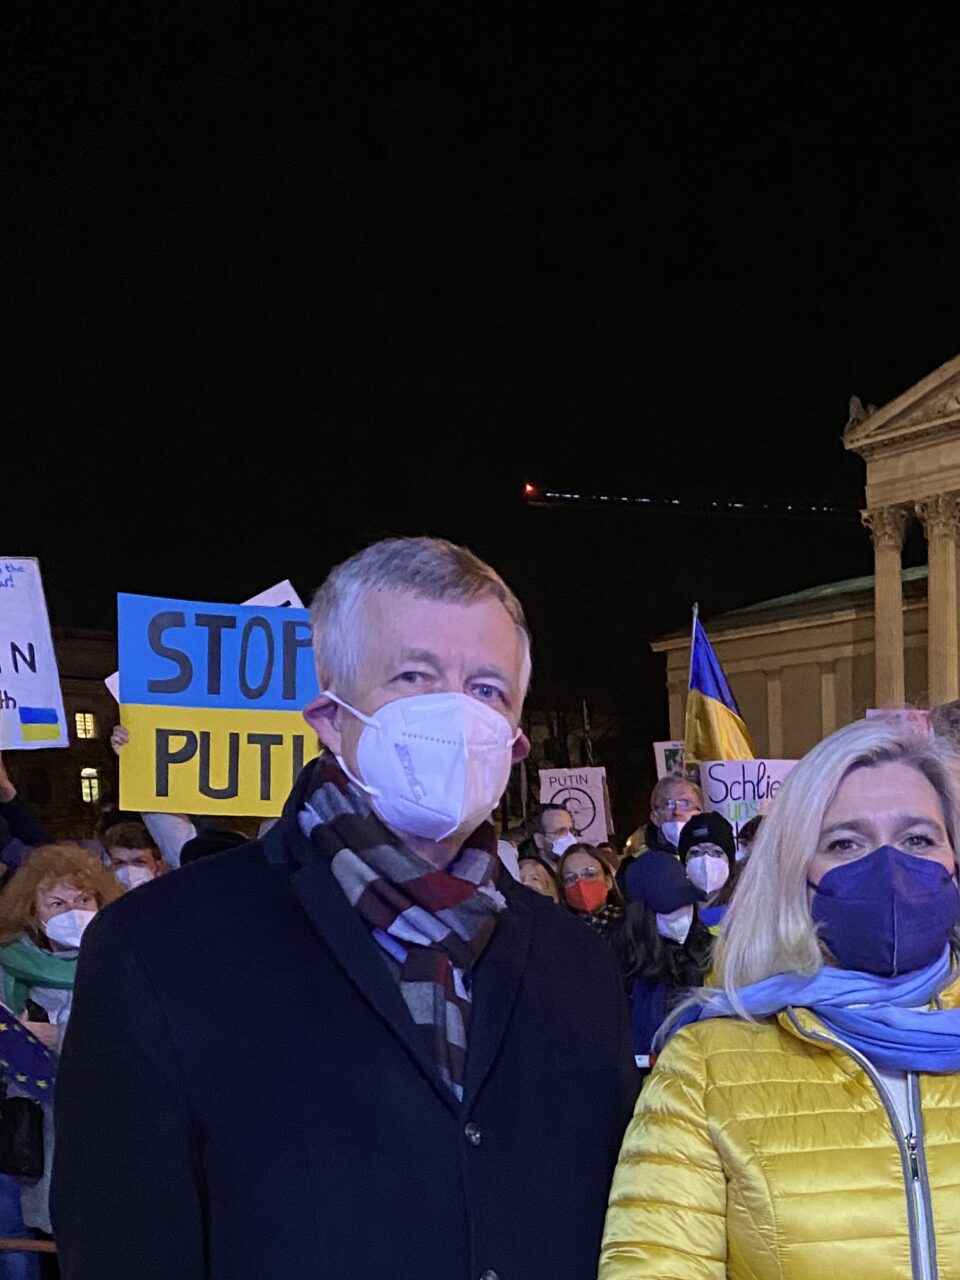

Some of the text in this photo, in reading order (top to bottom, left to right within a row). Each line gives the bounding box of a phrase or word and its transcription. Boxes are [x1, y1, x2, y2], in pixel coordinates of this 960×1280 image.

[147, 610, 312, 701] STOP
[155, 728, 305, 802] PUTI
[549, 774, 589, 788] PUTIN
[708, 761, 783, 804] Schlie
[726, 800, 760, 822] uns
